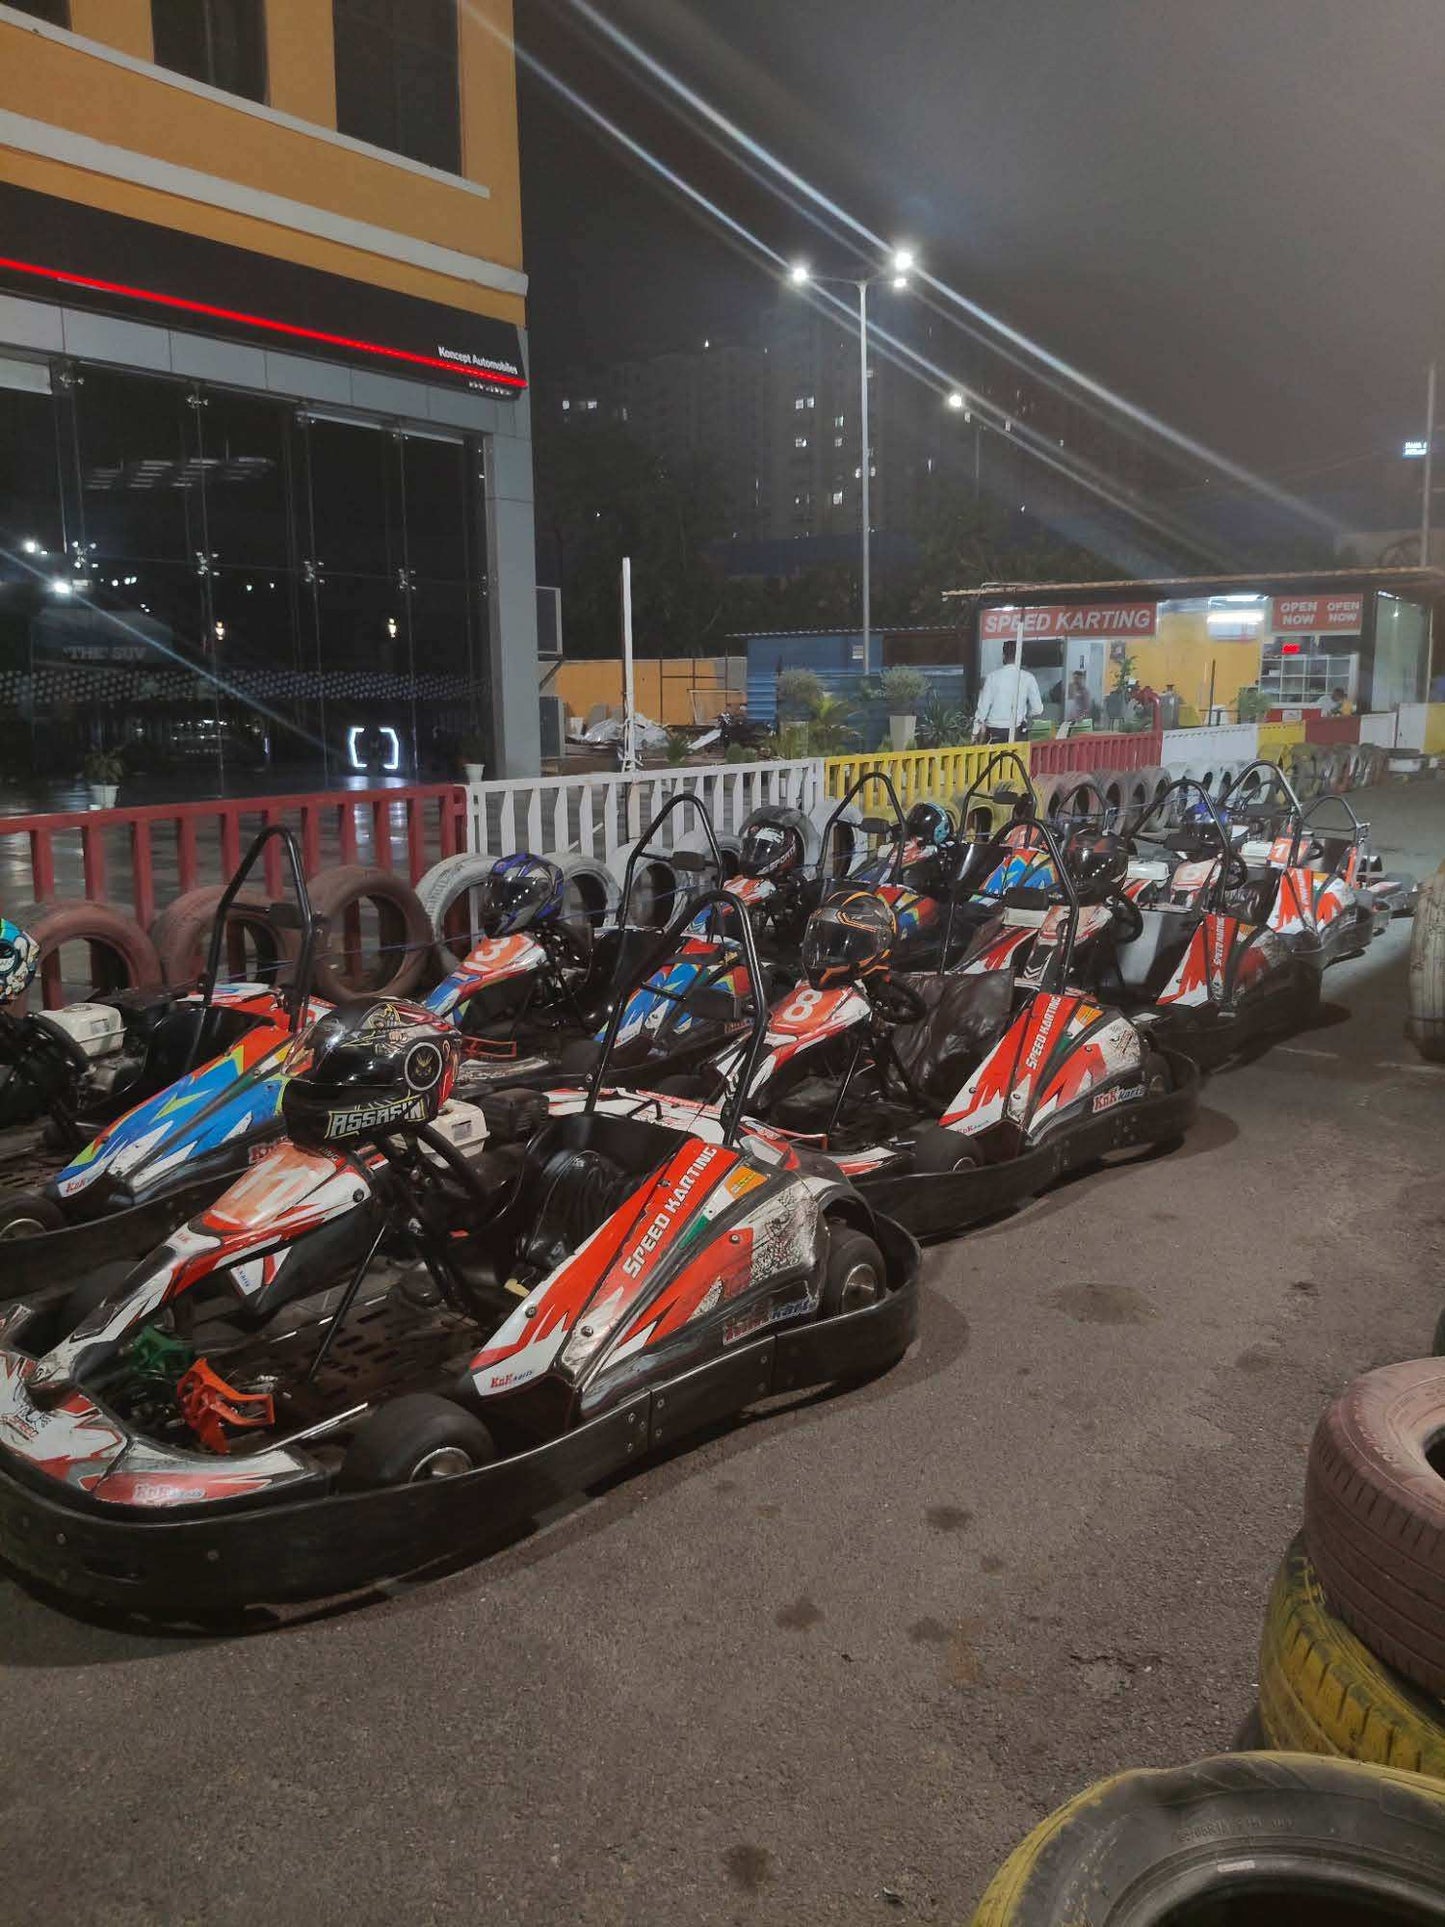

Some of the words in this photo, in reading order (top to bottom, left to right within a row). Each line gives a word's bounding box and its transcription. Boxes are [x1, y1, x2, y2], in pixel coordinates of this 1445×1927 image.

[437, 345, 472, 364] Koncept
[472, 354, 519, 375] Automobiles
[1280, 601, 1318, 613] OPEN
[1327, 601, 1360, 612] OPEN
[1328, 612, 1358, 622] NOW
[985, 613, 1051, 633] SPEED
[1055, 609, 1150, 632] KARTING
[1282, 614, 1315, 625] NOW
[111, 647, 147, 660] SUV
[782, 988, 824, 1022] 8
[1025, 1033, 1048, 1070] SPEED
[1039, 994, 1062, 1035] KARTING
[329, 1098, 423, 1137] ASSASIN
[622, 1212, 671, 1279] SPEED
[663, 1146, 718, 1215] KARTING
